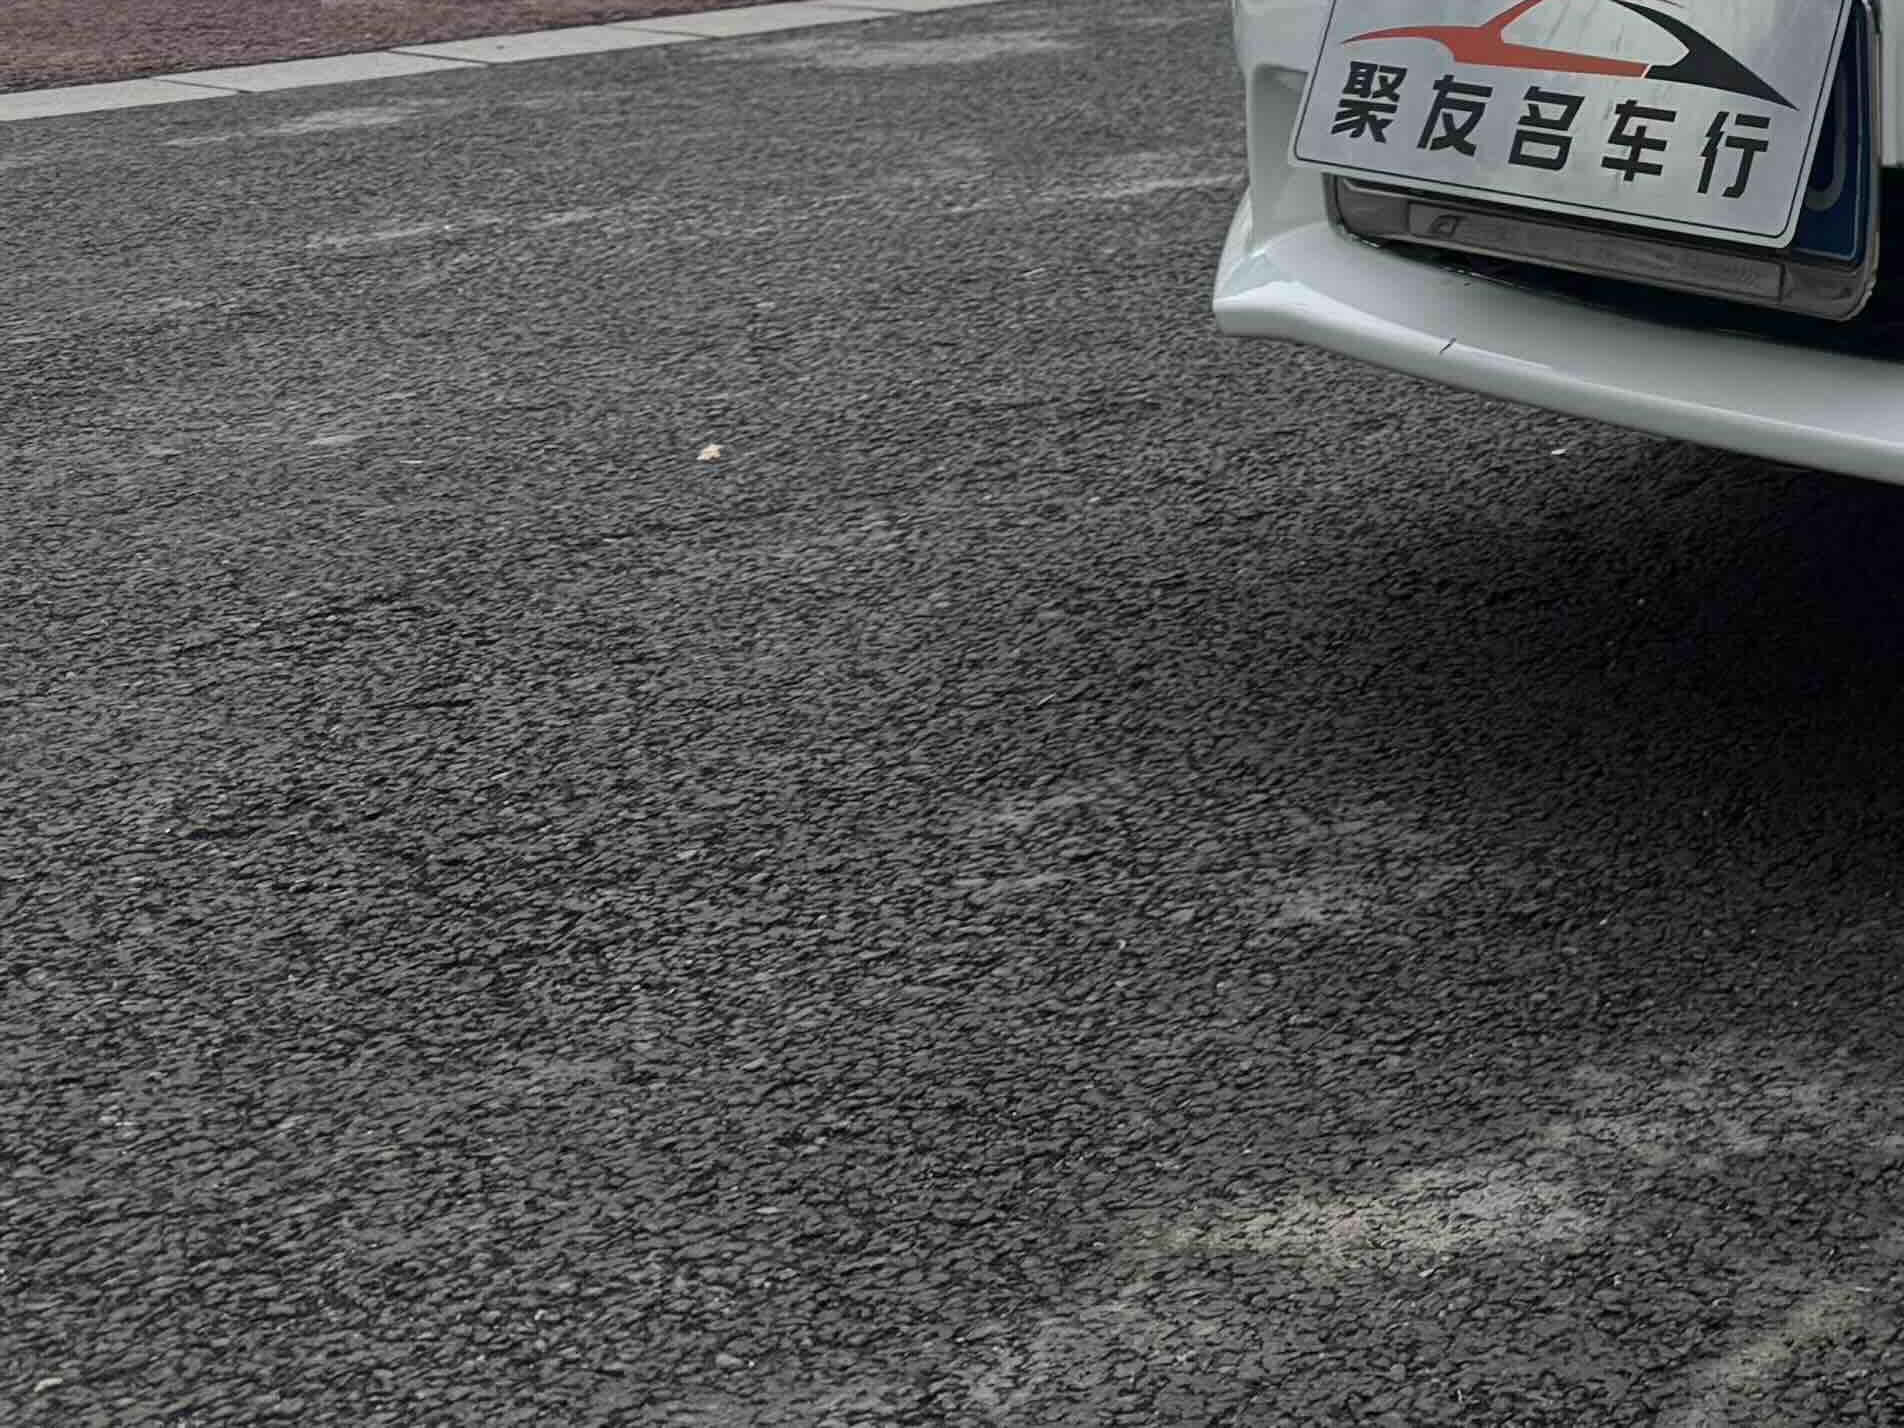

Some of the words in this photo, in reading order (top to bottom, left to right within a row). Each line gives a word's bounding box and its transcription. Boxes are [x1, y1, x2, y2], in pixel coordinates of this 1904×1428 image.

[1330, 60, 1771, 200] 聚友名车行
